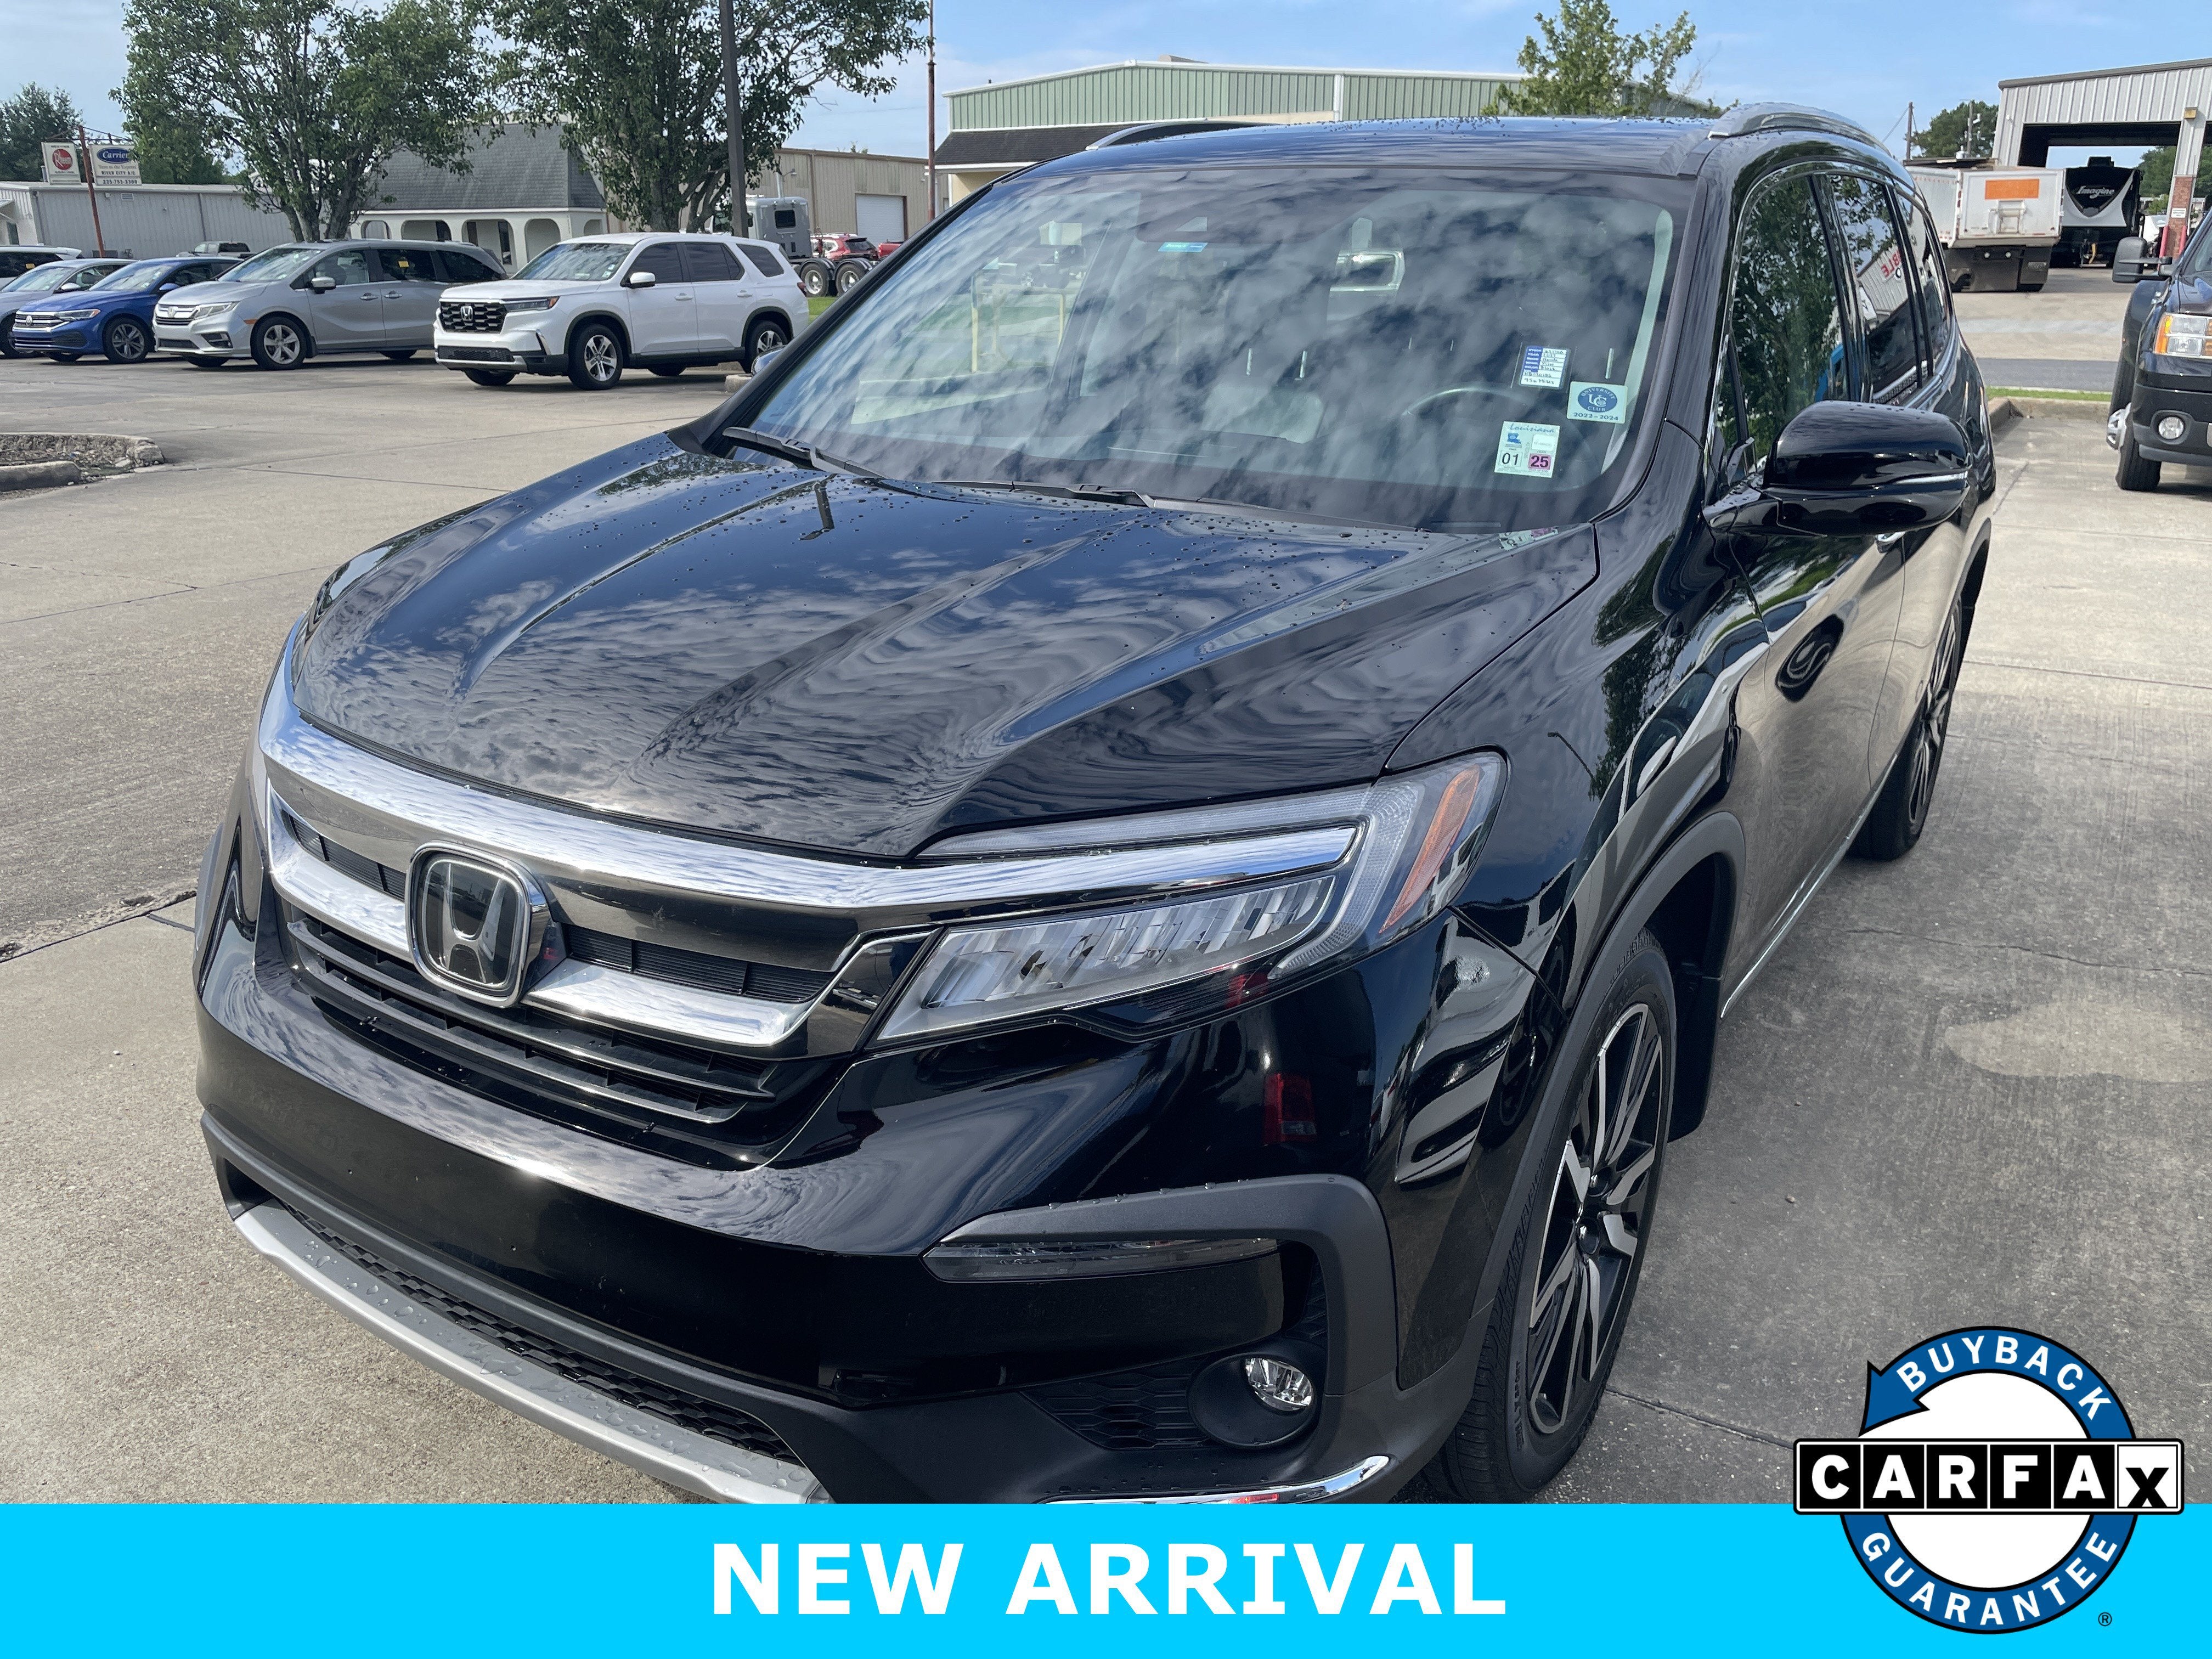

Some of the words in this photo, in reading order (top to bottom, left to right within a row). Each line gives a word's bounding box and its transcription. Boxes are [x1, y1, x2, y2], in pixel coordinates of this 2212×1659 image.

[2076, 185, 2115, 199] Imagine
[1581, 387, 1616, 399] UNIVERSITY
[1510, 423, 1554, 433] Louisiana
[1502, 452, 1519, 465] 01
[1531, 455, 1549, 468] 25
